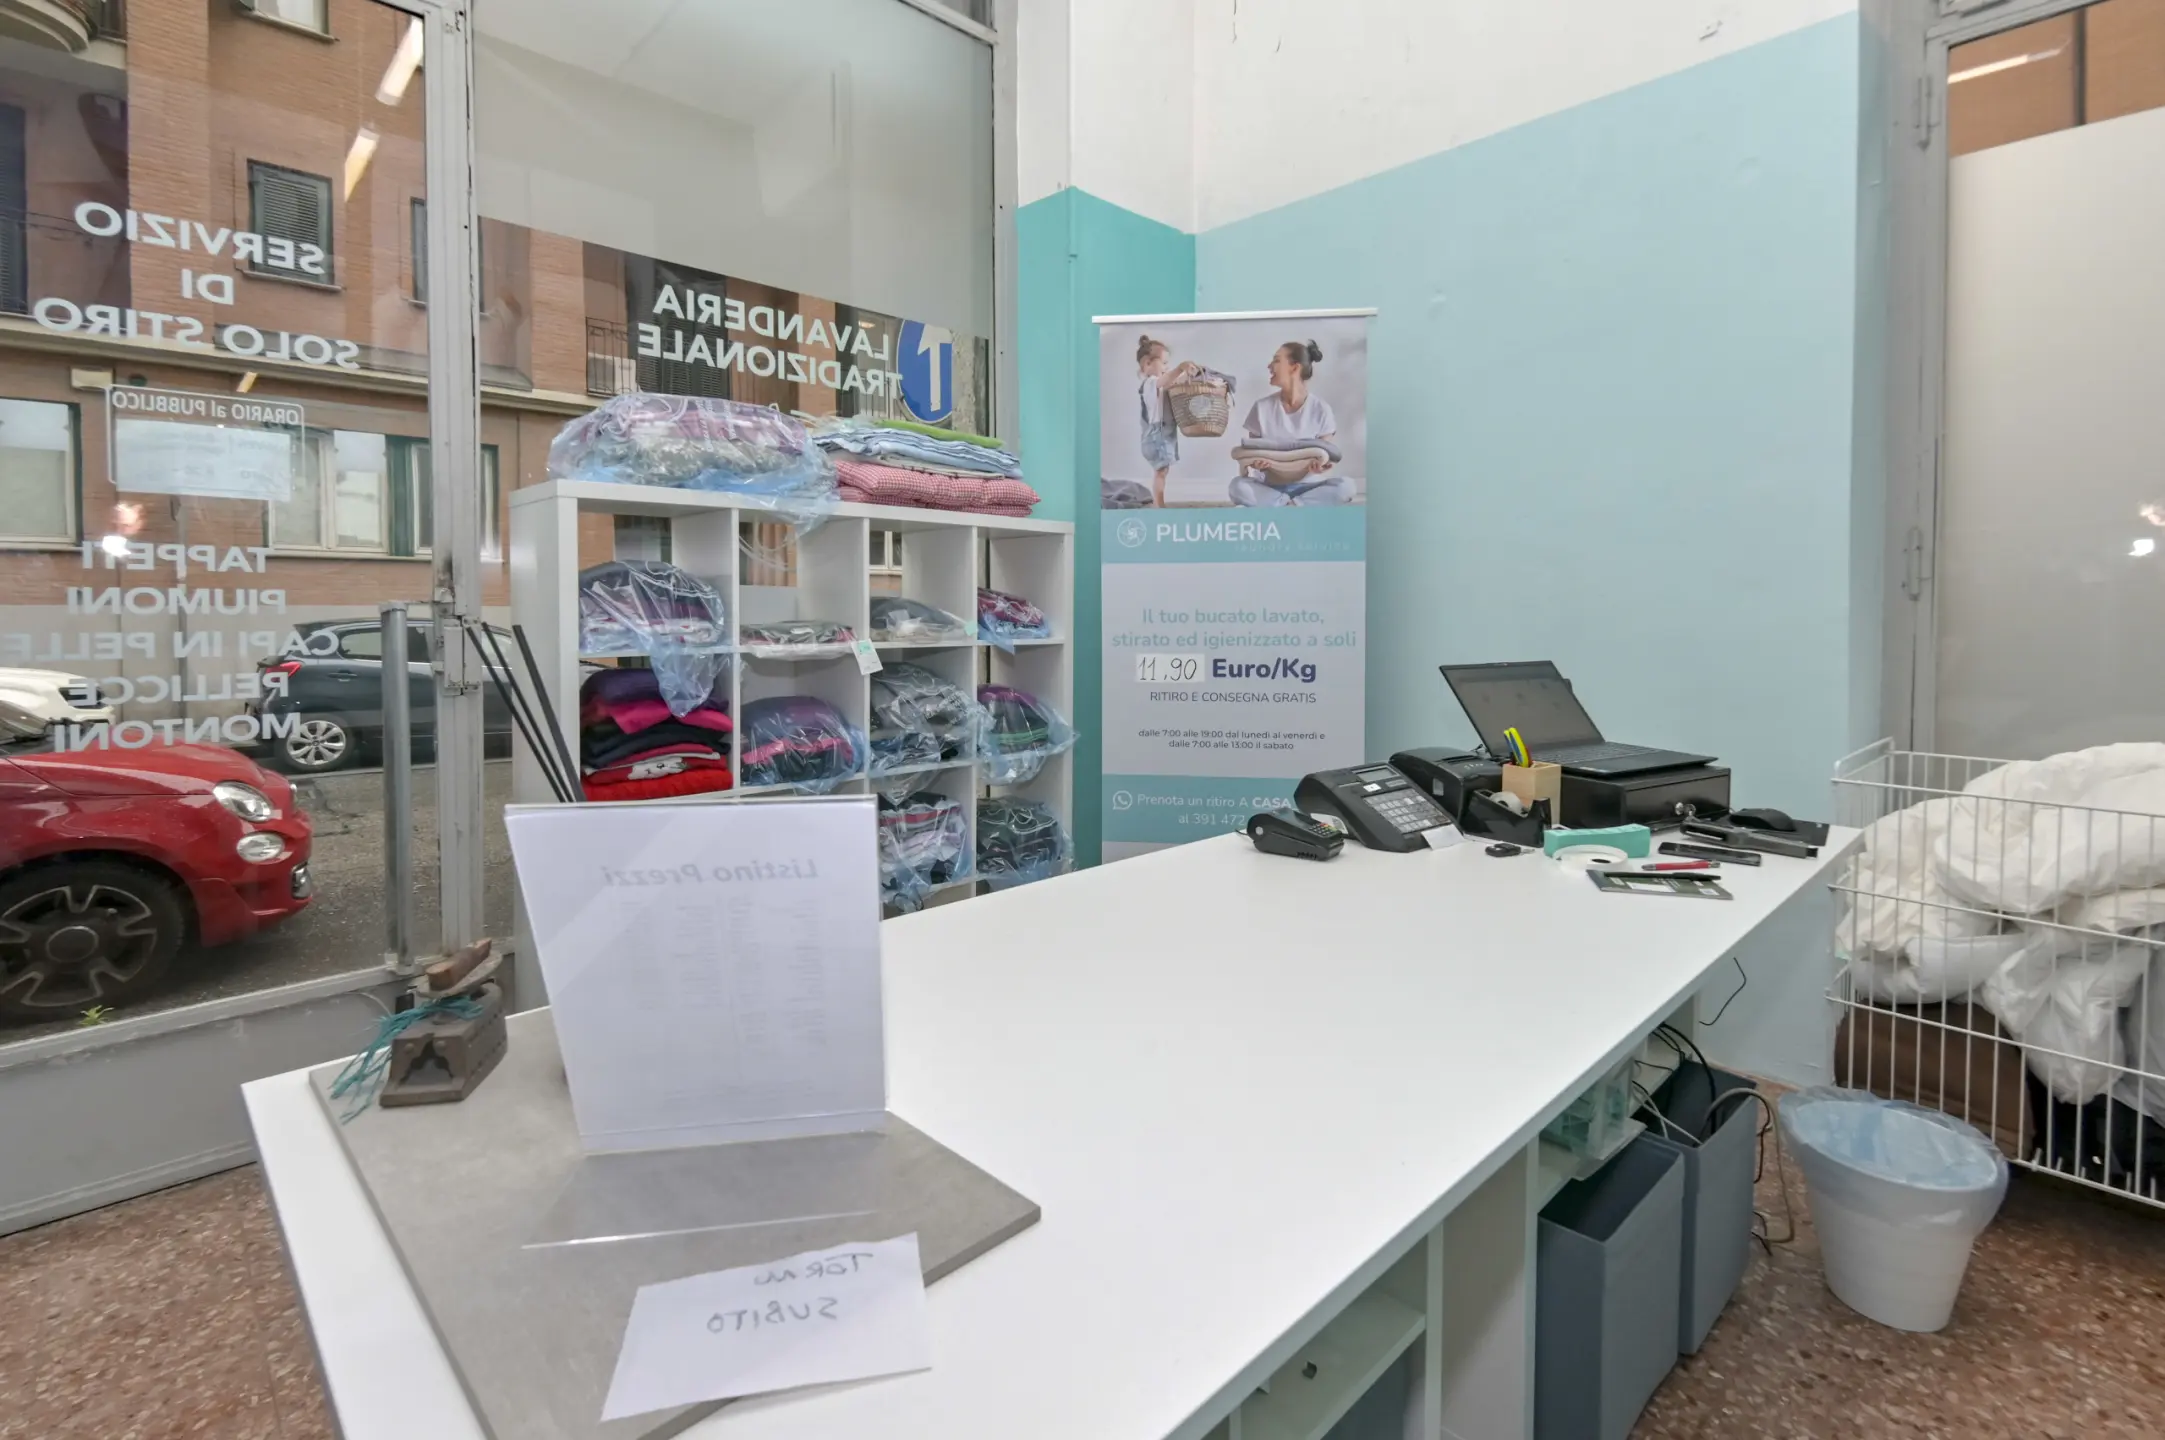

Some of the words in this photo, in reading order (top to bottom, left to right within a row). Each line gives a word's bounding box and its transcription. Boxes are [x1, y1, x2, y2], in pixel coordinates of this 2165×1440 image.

[1156, 522, 1281, 542] PLUMERIA
[1142, 608, 1153, 623] Il
[1159, 611, 1190, 623] tuo
[1195, 608, 1257, 623] bucato
[1263, 608, 1324, 625] lavato,
[1112, 632, 1170, 648] stirato
[1176, 632, 1198, 647] ed
[1204, 632, 1301, 650] igienizzato
[1307, 635, 1317, 647] a
[1324, 631, 1356, 647] soli
[1212, 658, 1316, 683] Euro/Kg
[1150, 691, 1188, 702] RITIRO
[1192, 692, 1198, 702] E
[1202, 692, 1269, 703] CONSEGNA
[1273, 692, 1316, 703] GRATIS
[1138, 729, 1160, 738] dalle
[1162, 729, 1181, 738] 7:00
[1183, 729, 1199, 739] alle
[1201, 730, 1223, 739] 19:00
[1226, 730, 1239, 739] dal
[1272, 731, 1281, 740] al
[1169, 739, 1190, 748] dalle
[1192, 740, 1211, 749] 7:00
[1213, 740, 1229, 749] alle
[1255, 741, 1262, 749] il
[1263, 741, 1294, 750] sabato
[1137, 794, 1184, 806] Prenota
[1187, 797, 1202, 806] un
[1206, 796, 1235, 807] ritiro
[1239, 797, 1249, 807] A
[1252, 797, 1292, 808] CASA
[1178, 813, 1189, 824] al
[1194, 813, 1216, 825] 391
